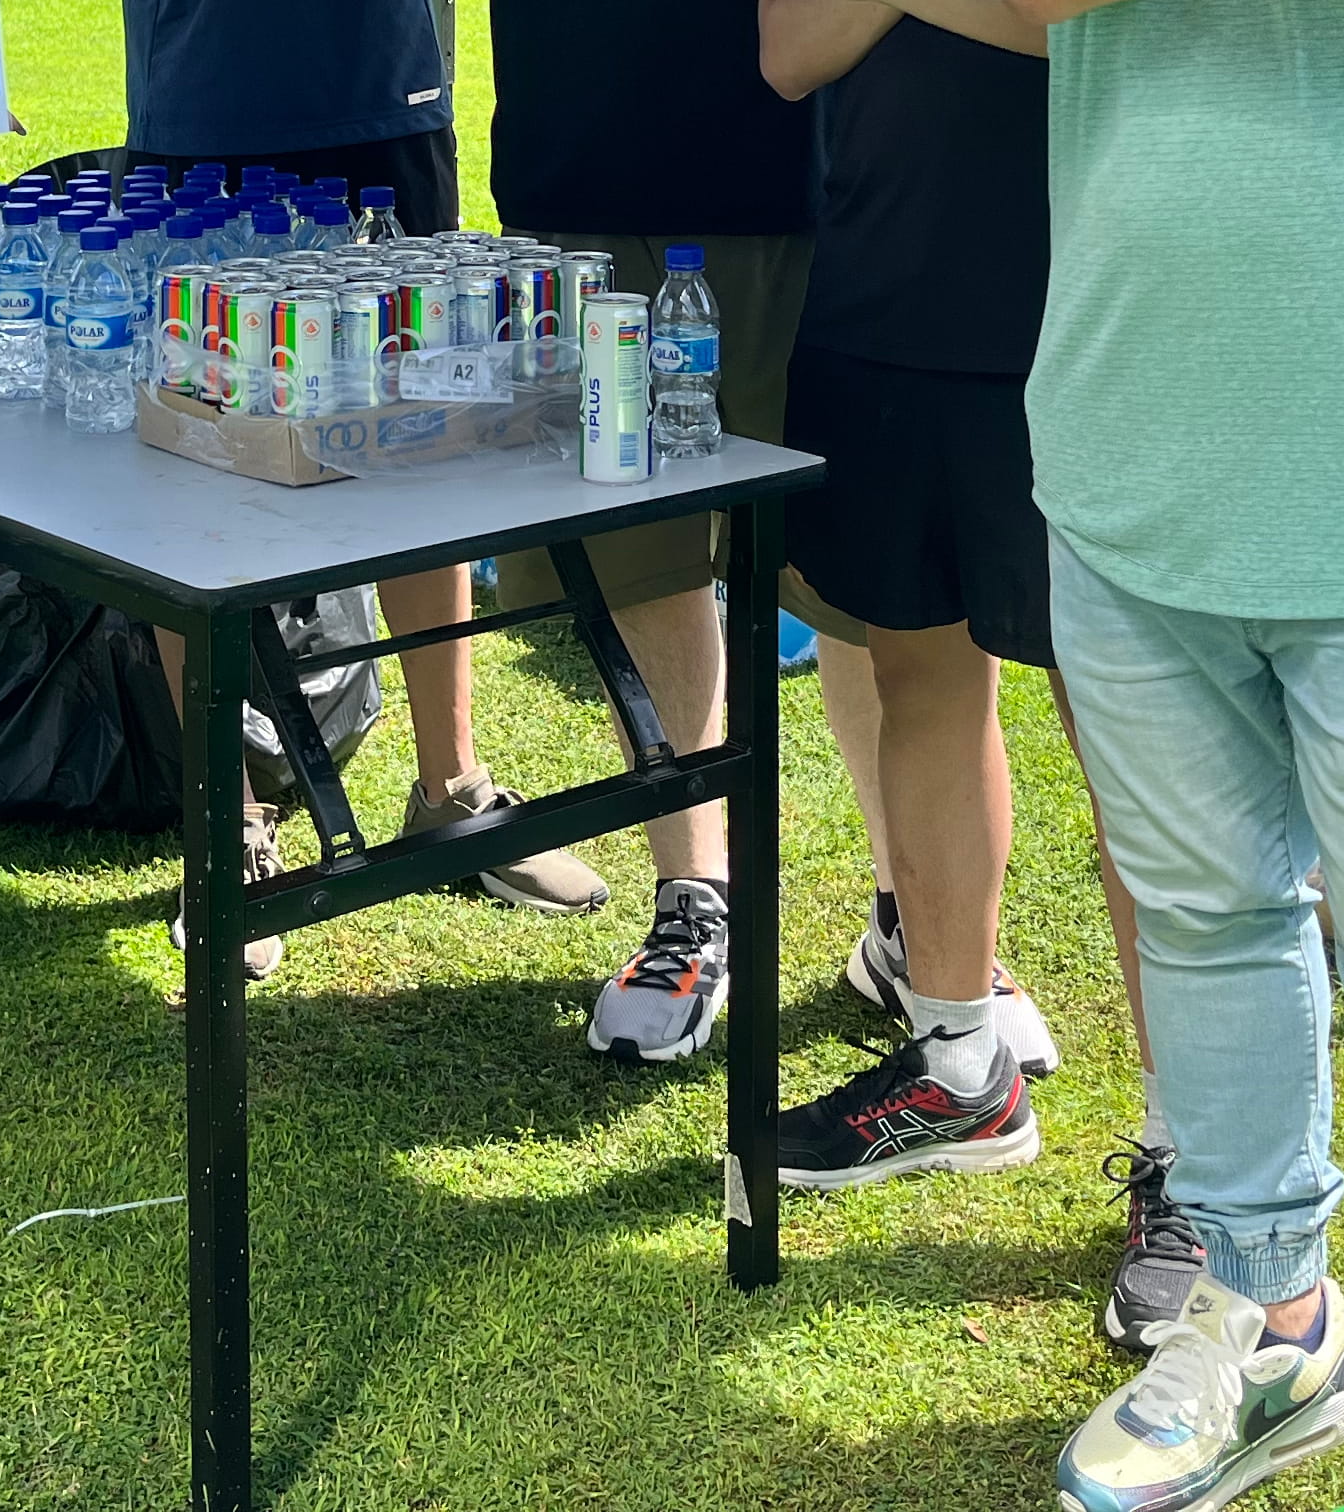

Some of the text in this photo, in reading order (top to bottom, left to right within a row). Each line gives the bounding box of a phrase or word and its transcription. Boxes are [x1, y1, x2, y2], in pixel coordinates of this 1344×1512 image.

[70, 327, 105, 338] POLAR
[453, 364, 474, 381] A2
[589, 377, 600, 427] PLUS
